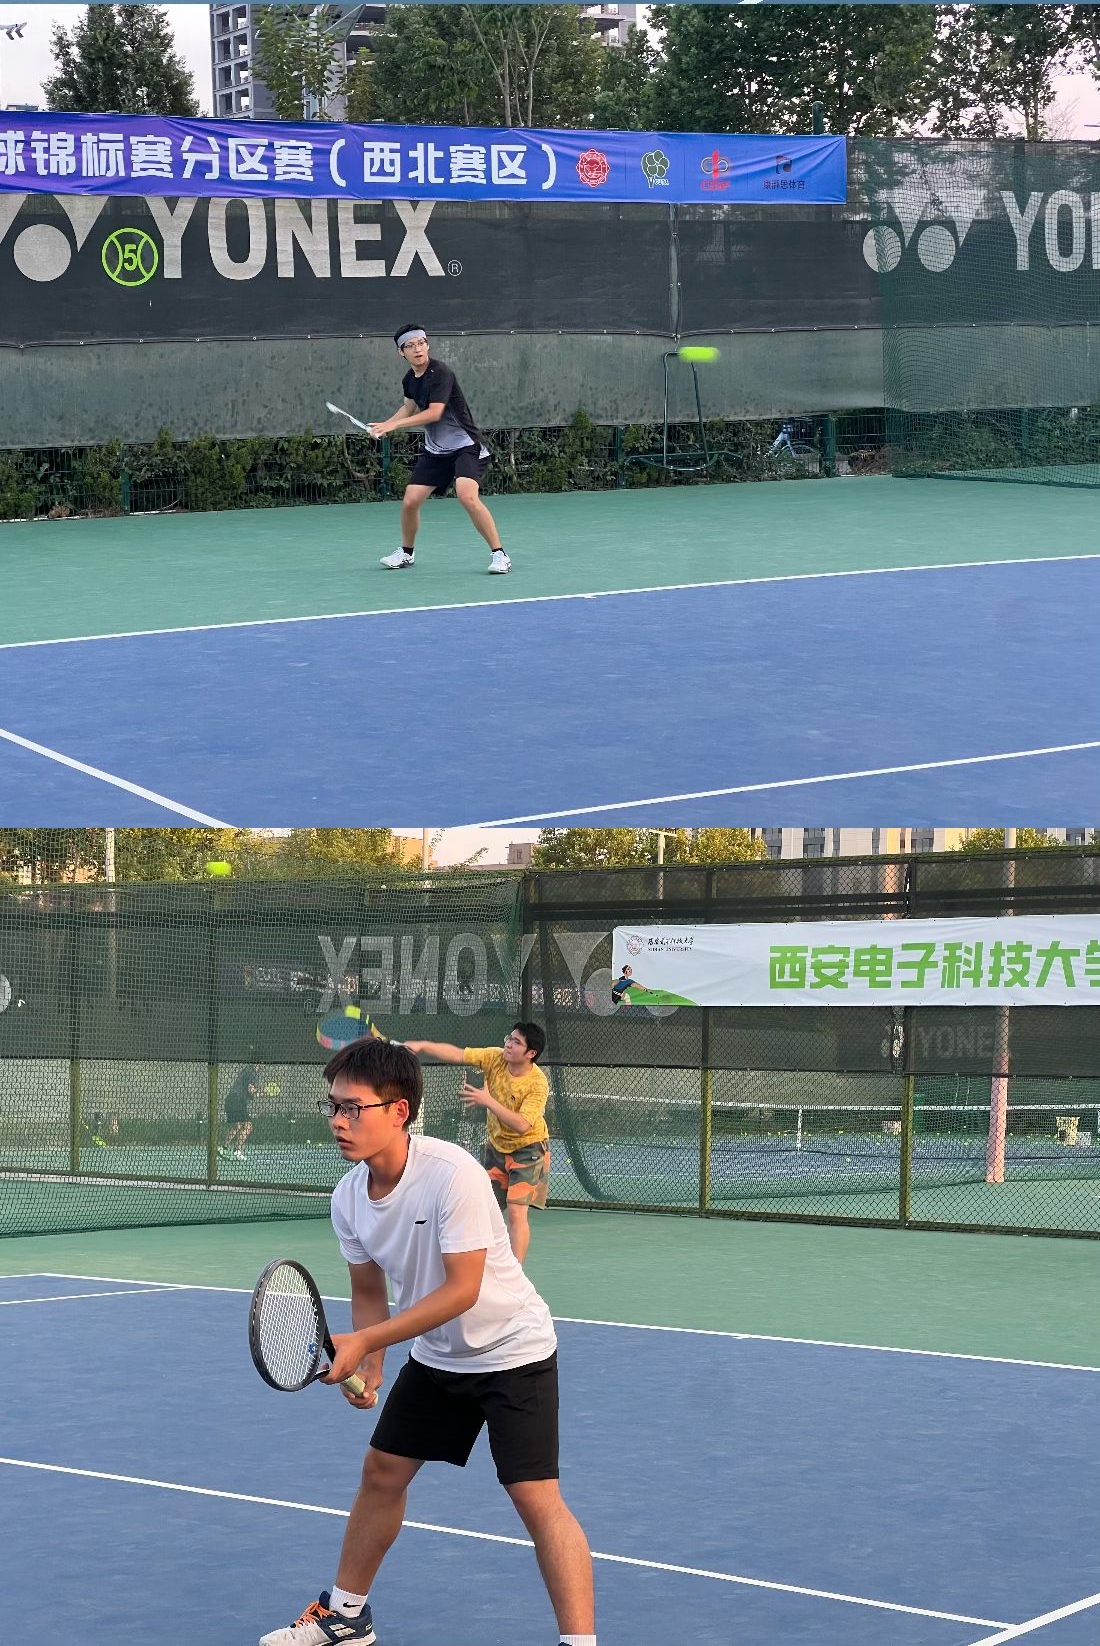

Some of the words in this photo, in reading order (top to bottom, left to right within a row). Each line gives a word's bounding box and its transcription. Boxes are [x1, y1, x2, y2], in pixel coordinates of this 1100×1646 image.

[144, 196, 446, 280] YONEX
[123, 244, 138, 271] 5
[918, 1025, 1013, 1057] YONE
